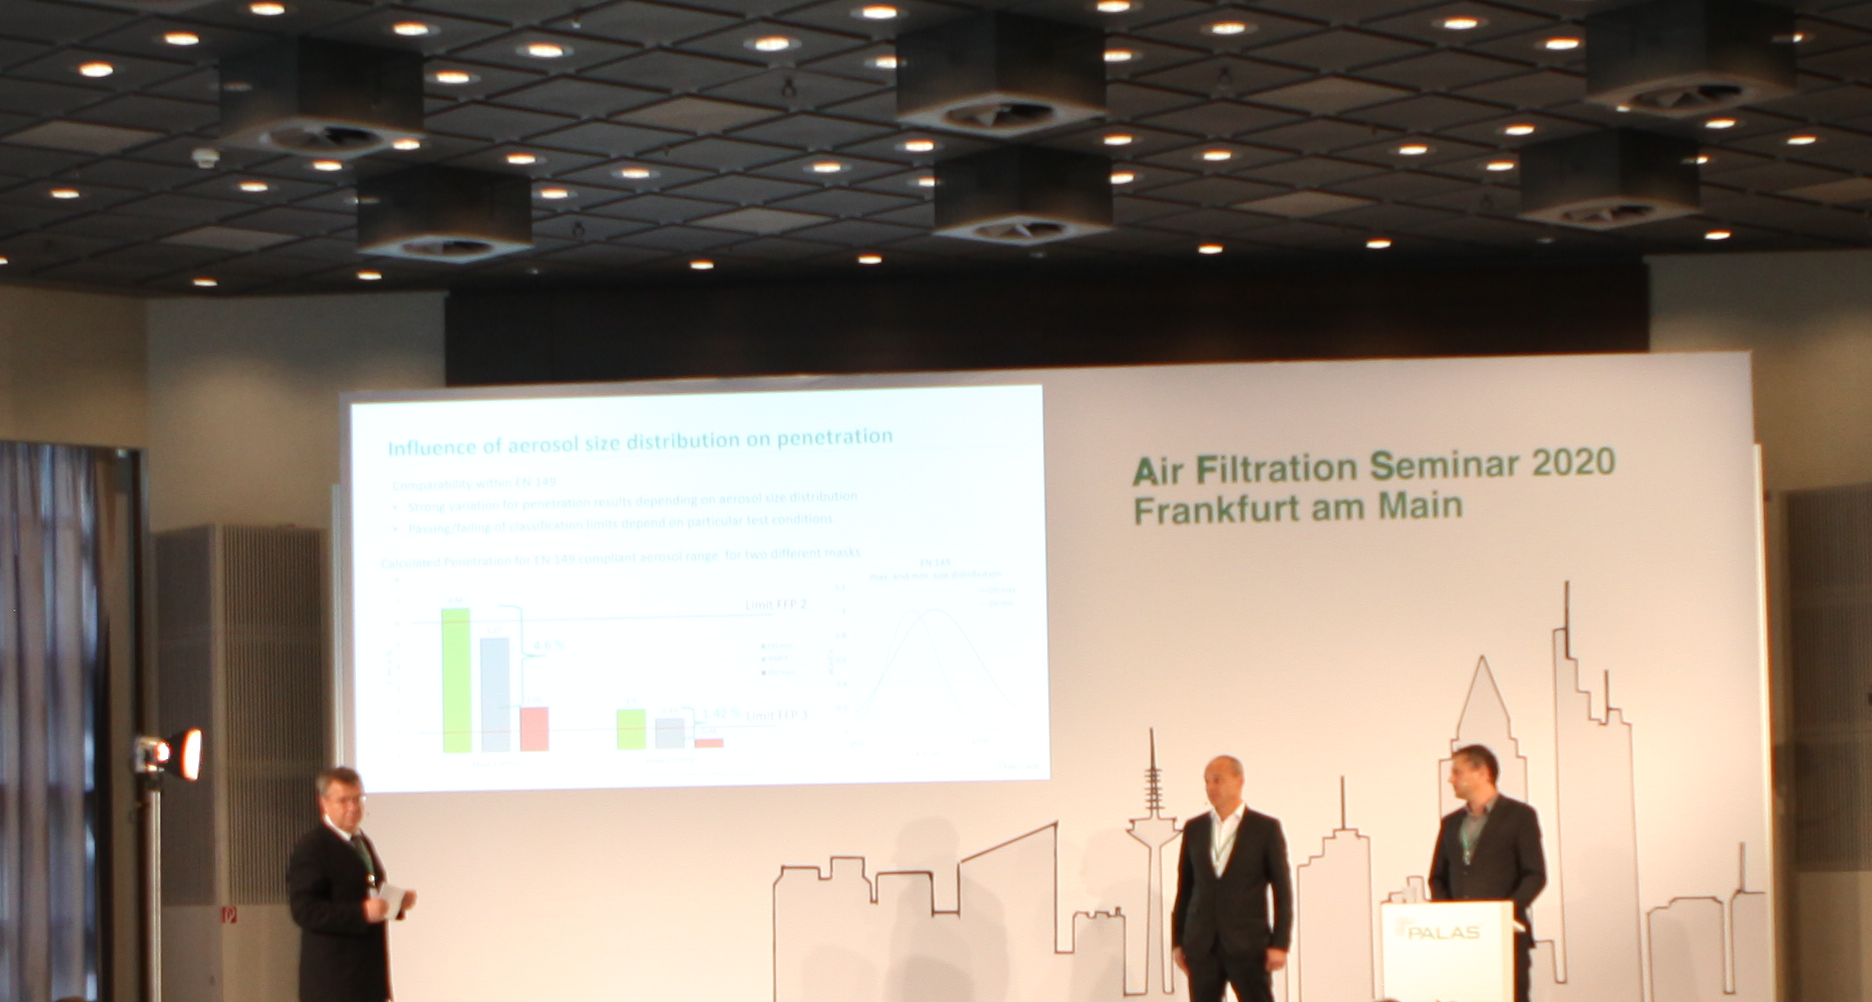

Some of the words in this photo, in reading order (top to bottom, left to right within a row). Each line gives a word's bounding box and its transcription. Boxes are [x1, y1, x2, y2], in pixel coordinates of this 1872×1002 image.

[388, 439, 477, 457] Influence
[483, 436, 502, 455] of
[508, 435, 579, 454] aerosol
[585, 435, 620, 452] size
[627, 431, 740, 451] distribution
[746, 433, 770, 447] on
[777, 427, 893, 450] penetration
[1132, 454, 1184, 487] Air
[1196, 451, 1358, 485] Filtration
[1370, 448, 1520, 481] Seminar
[1532, 447, 1616, 477] 2020
[392, 480, 472, 492] Comparability
[476, 479, 512, 490] within
[515, 478, 531, 488] EN
[535, 477, 557, 487] 149
[408, 502, 446, 515] Strong
[449, 500, 499, 512] variation
[503, 500, 519, 510] for
[523, 498, 590, 511] penetration
[594, 496, 632, 508] results
[635, 494, 698, 509] depending
[701, 496, 716, 505] on
[719, 493, 762, 505] aerosol
[765, 493, 786, 503] size
[790, 490, 858, 503] distribution
[1133, 494, 1301, 526] Frankfurt
[1312, 496, 1365, 522] am
[1378, 492, 1463, 521] Main
[409, 523, 491, 536] Passing/failing
[495, 522, 506, 532] of
[510, 520, 583, 532] classification
[586, 519, 617, 530] limits
[621, 517, 665, 530] depend
[669, 518, 684, 528] on
[688, 516, 743, 529] particular
[747, 516, 769, 526] test
[772, 513, 833, 525] conditions
[381, 558, 441, 570] Calculated
[445, 556, 511, 568] Penetration
[515, 555, 530, 566] for
[535, 555, 550, 565] EN
[555, 555, 576, 564] 149
[579, 553, 636, 566] compliant
[640, 552, 682, 563] aerosol
[686, 552, 718, 563] range
[725, 549, 741, 560] for
[745, 549, 768, 560] two
[771, 548, 821, 559] different
[825, 548, 861, 558] masks
[745, 600, 773, 612] Limit
[776, 599, 797, 610] FFP
[800, 598, 808, 610] 2
[801, 709, 808, 720] 3
[1408, 926, 1480, 941] PALAS
